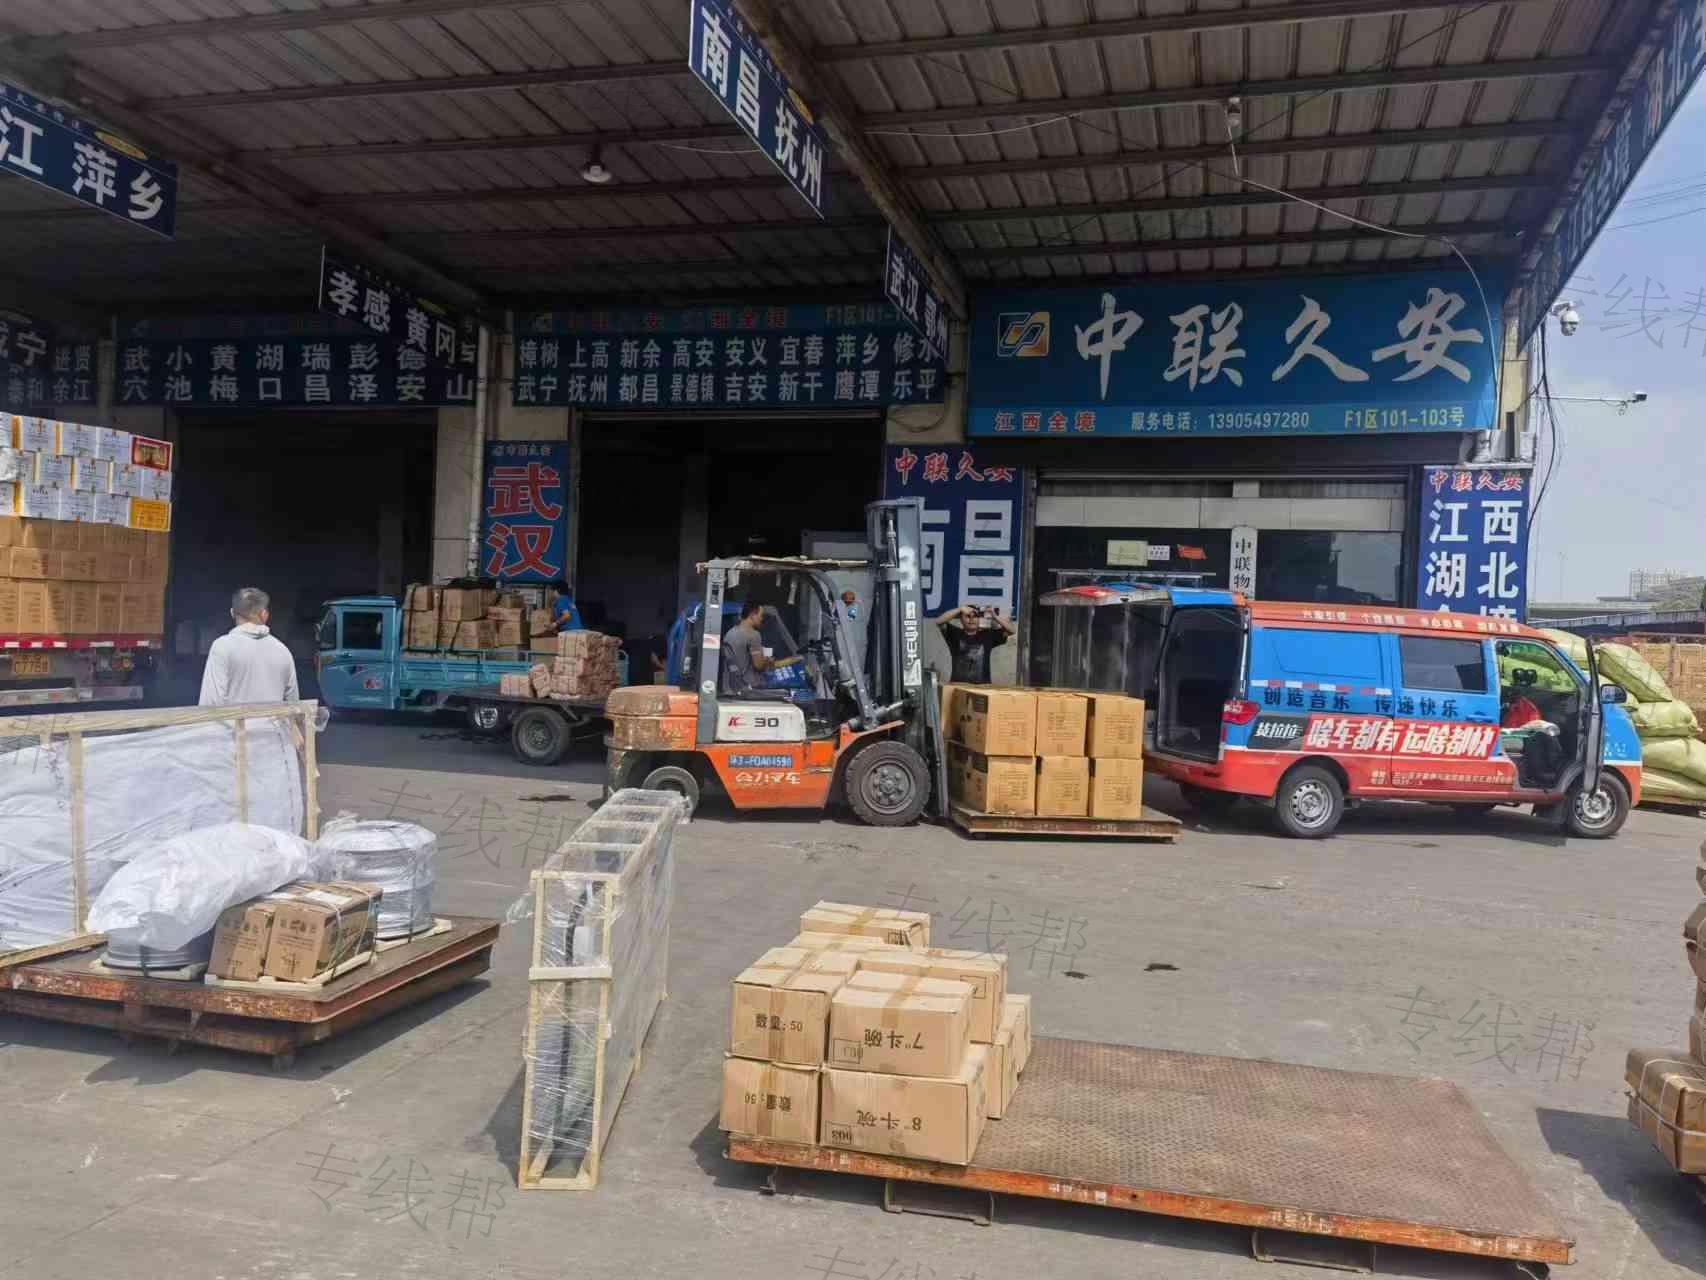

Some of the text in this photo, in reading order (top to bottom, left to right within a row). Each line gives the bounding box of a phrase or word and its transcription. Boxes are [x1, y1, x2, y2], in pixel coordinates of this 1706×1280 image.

[702, 5, 760, 138] 南昌
[775, 98, 822, 208] 抚州
[0, 105, 163, 220] 江 萍乡
[328, 269, 391, 332] 孝感
[404, 306, 456, 366] 黄冈
[568, 339, 608, 368] 上高
[620, 339, 661, 368] 新余
[672, 338, 714, 368] 高安
[725, 337, 768, 368] 安义
[779, 336, 824, 367] 宜春
[836, 333, 880, 365] 萍乡
[1075, 286, 1484, 400] 中联久安
[518, 375, 557, 402] 武宁
[568, 375, 608, 402] 抚州
[619, 374, 659, 402] 都昌
[724, 372, 768, 401] 吉安
[778, 372, 824, 400] 新干
[834, 369, 880, 401] 鹰潭
[892, 369, 937, 400] 乐平
[1208, 411, 1310, 430] 13905497280
[1345, 407, 1466, 429] F1区101-103号
[1430, 470, 1524, 494] 中联久安
[486, 462, 563, 577] 武汉
[1429, 499, 1523, 544] 江西
[1234, 537, 1252, 600] 中联物
[1425, 551, 1519, 599] 湖北
[754, 717, 779, 728] 30
[1307, 717, 1403, 752] 啥车都有
[1400, 722, 1495, 758] 运啥都快
